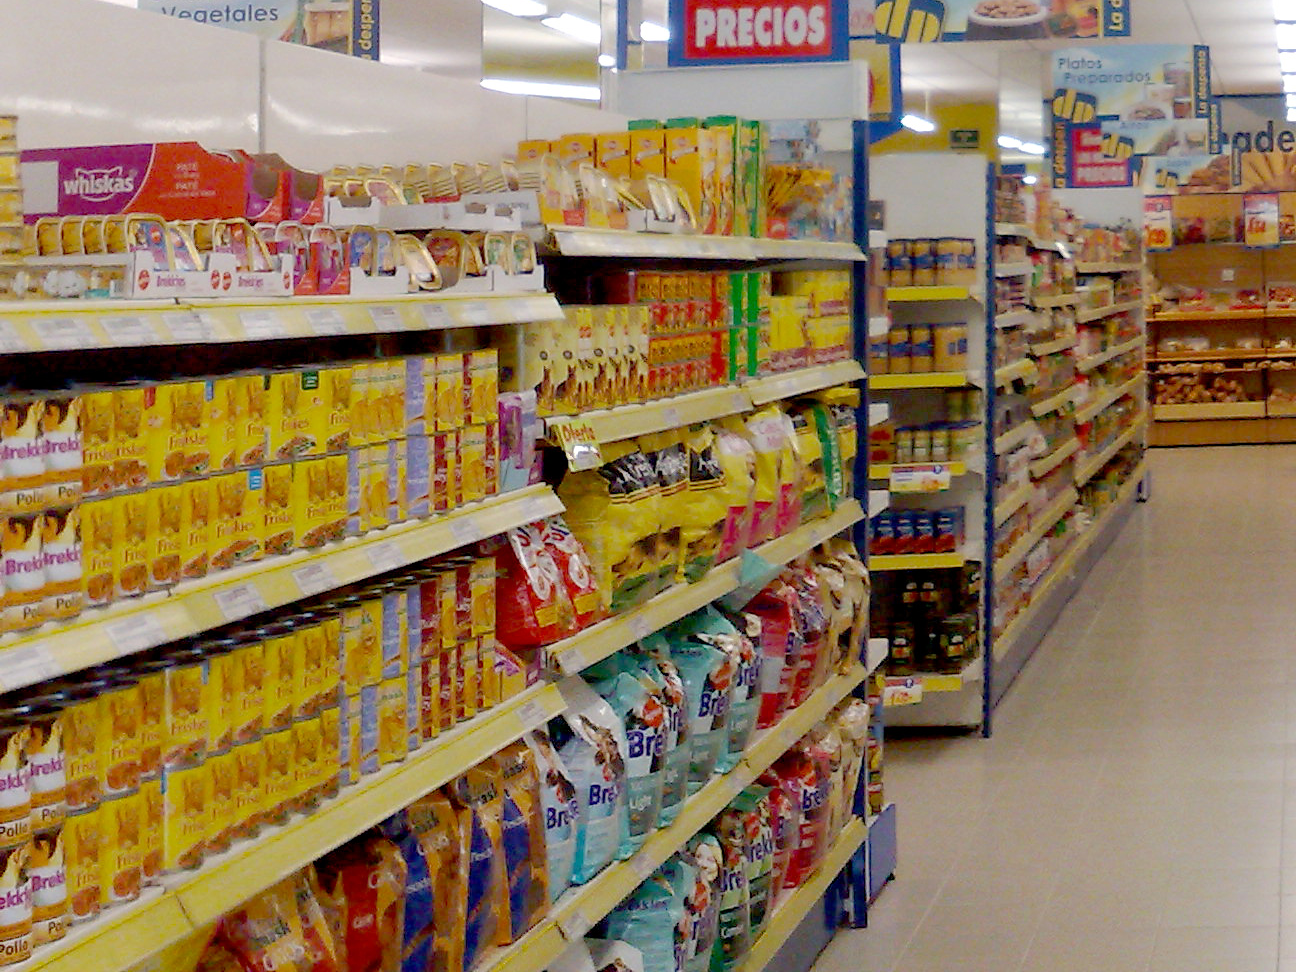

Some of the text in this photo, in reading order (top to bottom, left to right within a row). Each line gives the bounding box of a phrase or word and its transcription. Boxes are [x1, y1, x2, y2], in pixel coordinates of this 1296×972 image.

[695, 5, 826, 48] PRECIOS
[1109, 12, 1123, 31] La
[1058, 57, 1103, 70] Platos
[63, 175, 135, 196] whiskas
